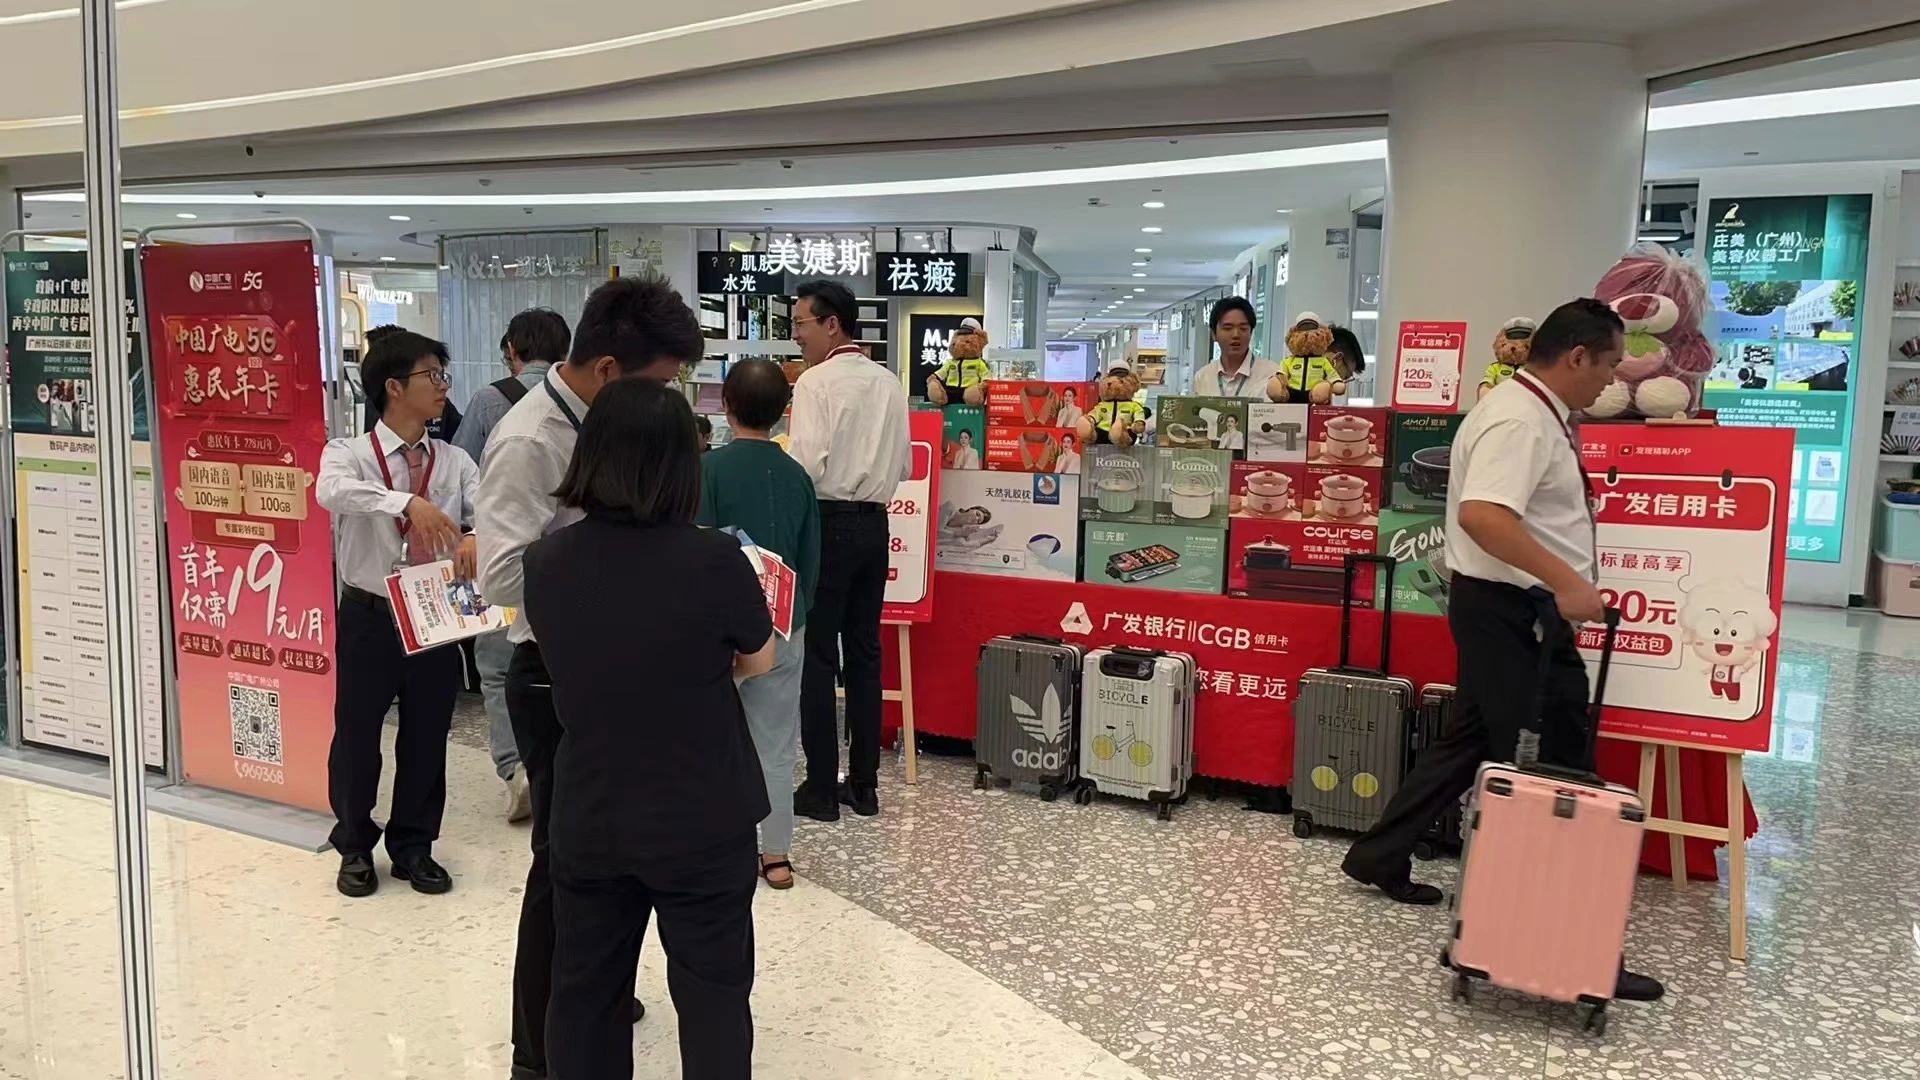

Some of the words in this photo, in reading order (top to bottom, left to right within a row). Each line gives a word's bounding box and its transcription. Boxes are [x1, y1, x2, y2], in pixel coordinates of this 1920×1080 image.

[767, 238, 872, 277] 美婕斯
[1712, 248, 1811, 264] 美容仪器工厂
[241, 270, 262, 291] 5G
[722, 273, 756, 292] 水光
[1403, 368, 1433, 379] 120元
[183, 364, 279, 409] 惠民年卡
[1095, 457, 1140, 468] Roman
[1172, 461, 1218, 472] Roman
[188, 465, 230, 485] 国内语音
[251, 470, 296, 490] 国内流量
[195, 491, 229, 508] 100分钟
[985, 487, 1032, 500] 天然乳胶枕
[260, 496, 291, 513] 100GB
[1598, 491, 1738, 519] 广发信用卡
[1303, 526, 1373, 541] course
[1787, 536, 1824, 551] 更多
[178, 542, 225, 588] 首年
[1600, 552, 1683, 571] 标最高享
[180, 588, 226, 629] 仅需
[1103, 612, 1186, 640] 广发银行
[1197, 623, 1251, 650] CGB
[1254, 633, 1289, 647] 信用卡
[1098, 689, 1149, 705] BICYCLE
[1317, 714, 1376, 733] BICYCLE
[242, 762, 284, 785] 969368
